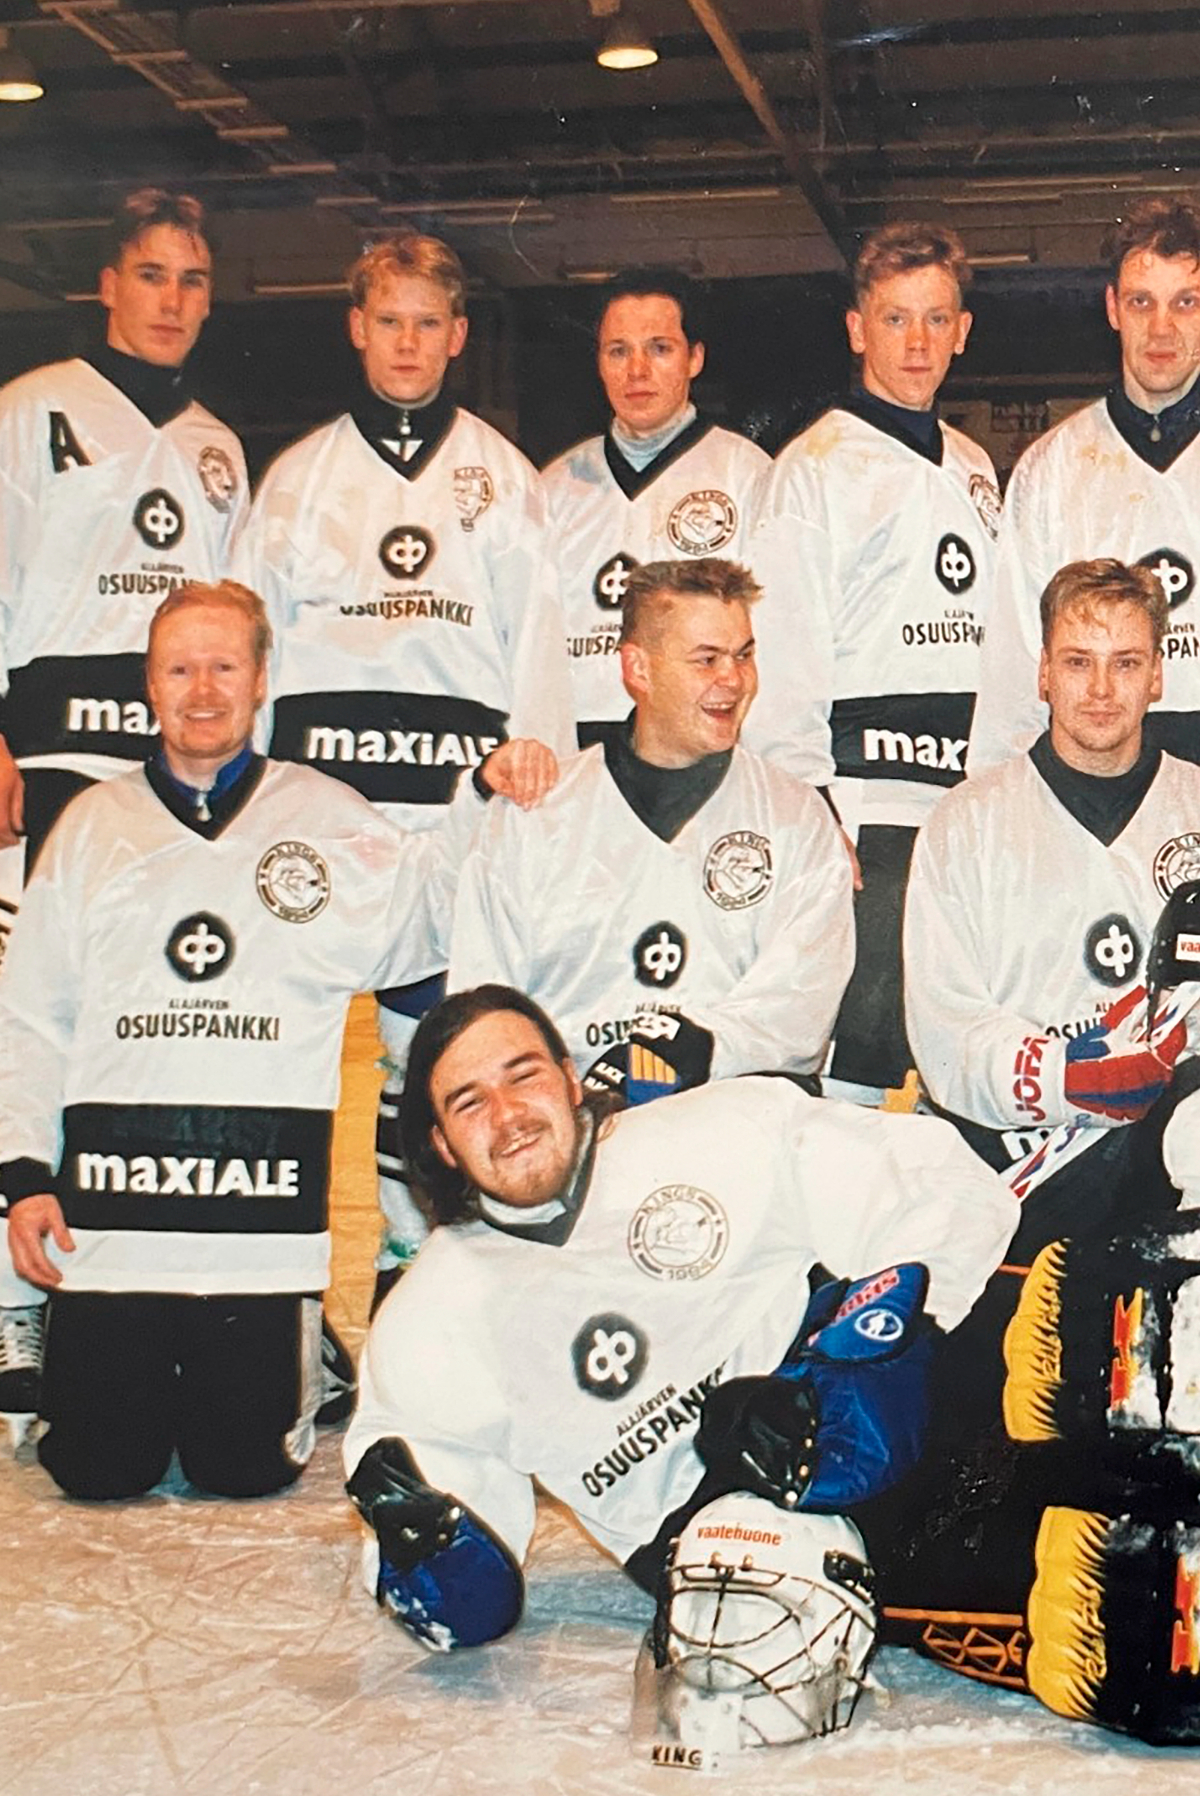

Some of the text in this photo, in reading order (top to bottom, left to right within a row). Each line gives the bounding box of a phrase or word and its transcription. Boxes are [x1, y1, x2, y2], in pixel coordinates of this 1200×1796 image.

[49, 411, 94, 474] A
[863, 728, 970, 772] max
[115, 1012, 280, 1042] OSUUSPANKKI
[1012, 1036, 1050, 1122] JOFA
[77, 1152, 300, 1197] maxiALE
